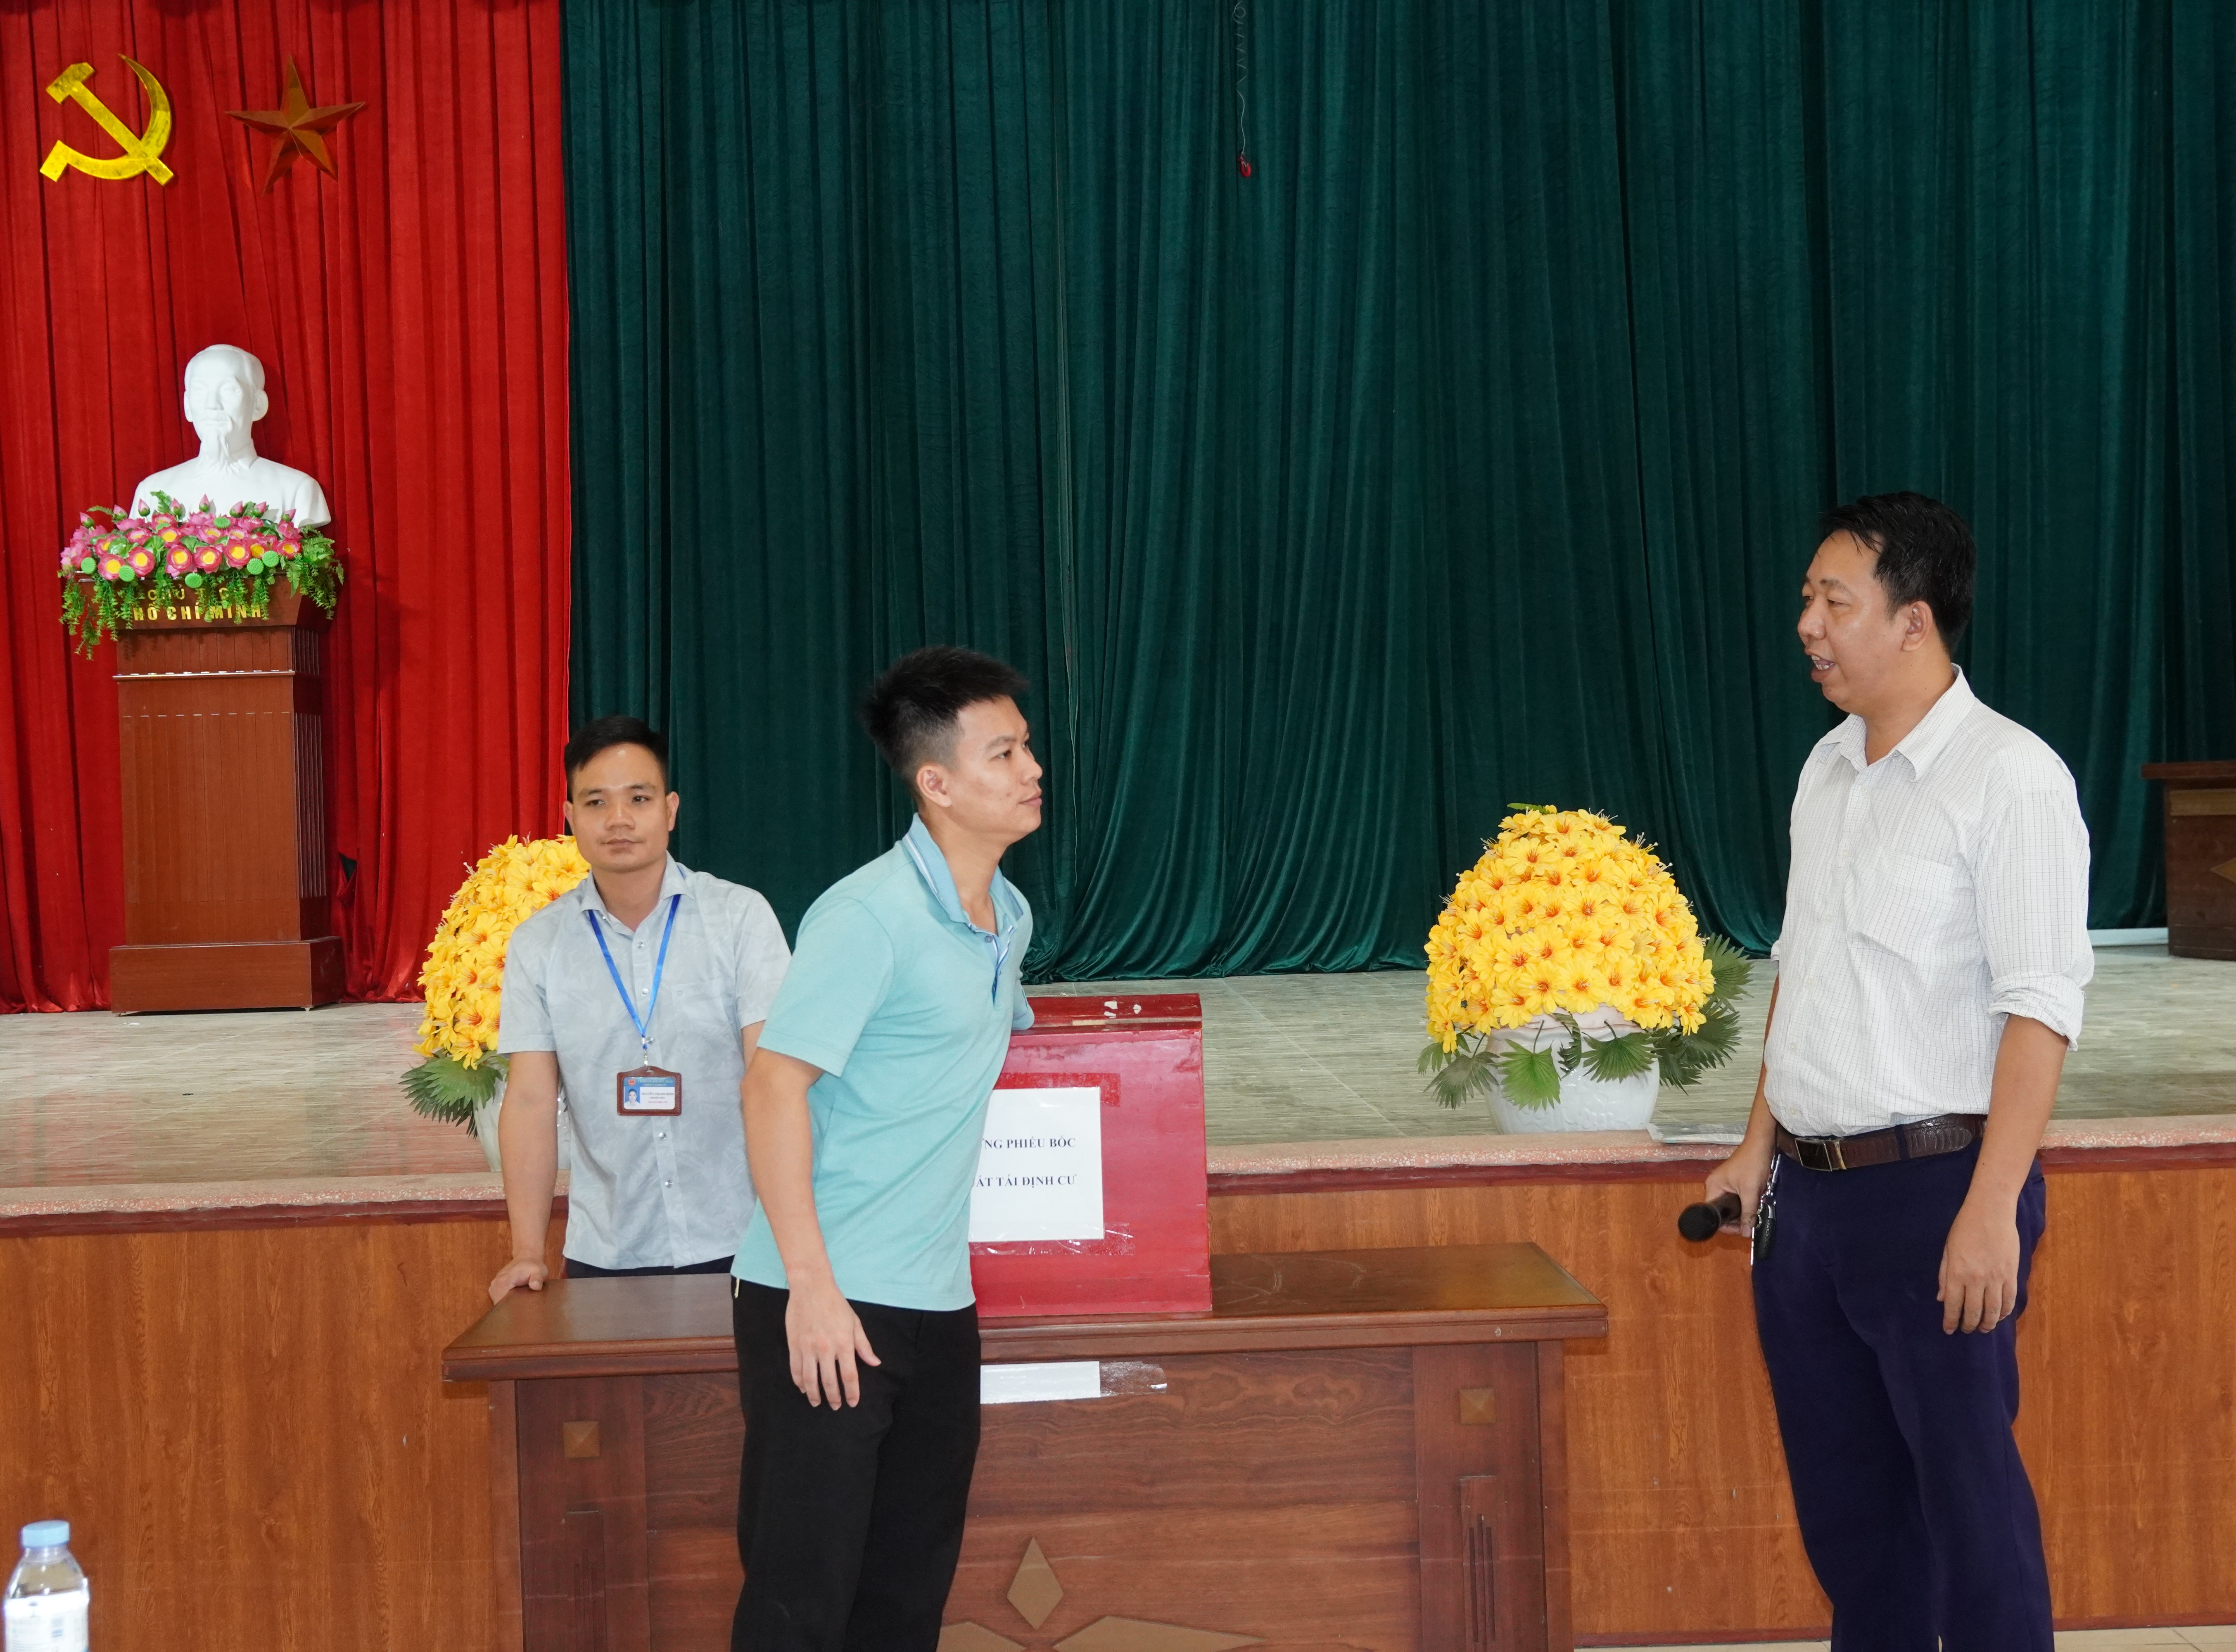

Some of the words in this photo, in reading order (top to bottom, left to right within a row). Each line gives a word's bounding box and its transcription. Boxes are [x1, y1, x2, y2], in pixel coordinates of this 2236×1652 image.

[167, 602, 200, 620] CHÍ
[209, 604, 261, 619] MINH
[983, 1138, 1002, 1149] NG
[1007, 1136, 1045, 1148] PHIẾU
[1050, 1135, 1075, 1147] BỐC
[996, 1174, 1017, 1187] TÁI
[1022, 1176, 1054, 1188] ĐỊNH
[1057, 1174, 1077, 1185] CƯ
